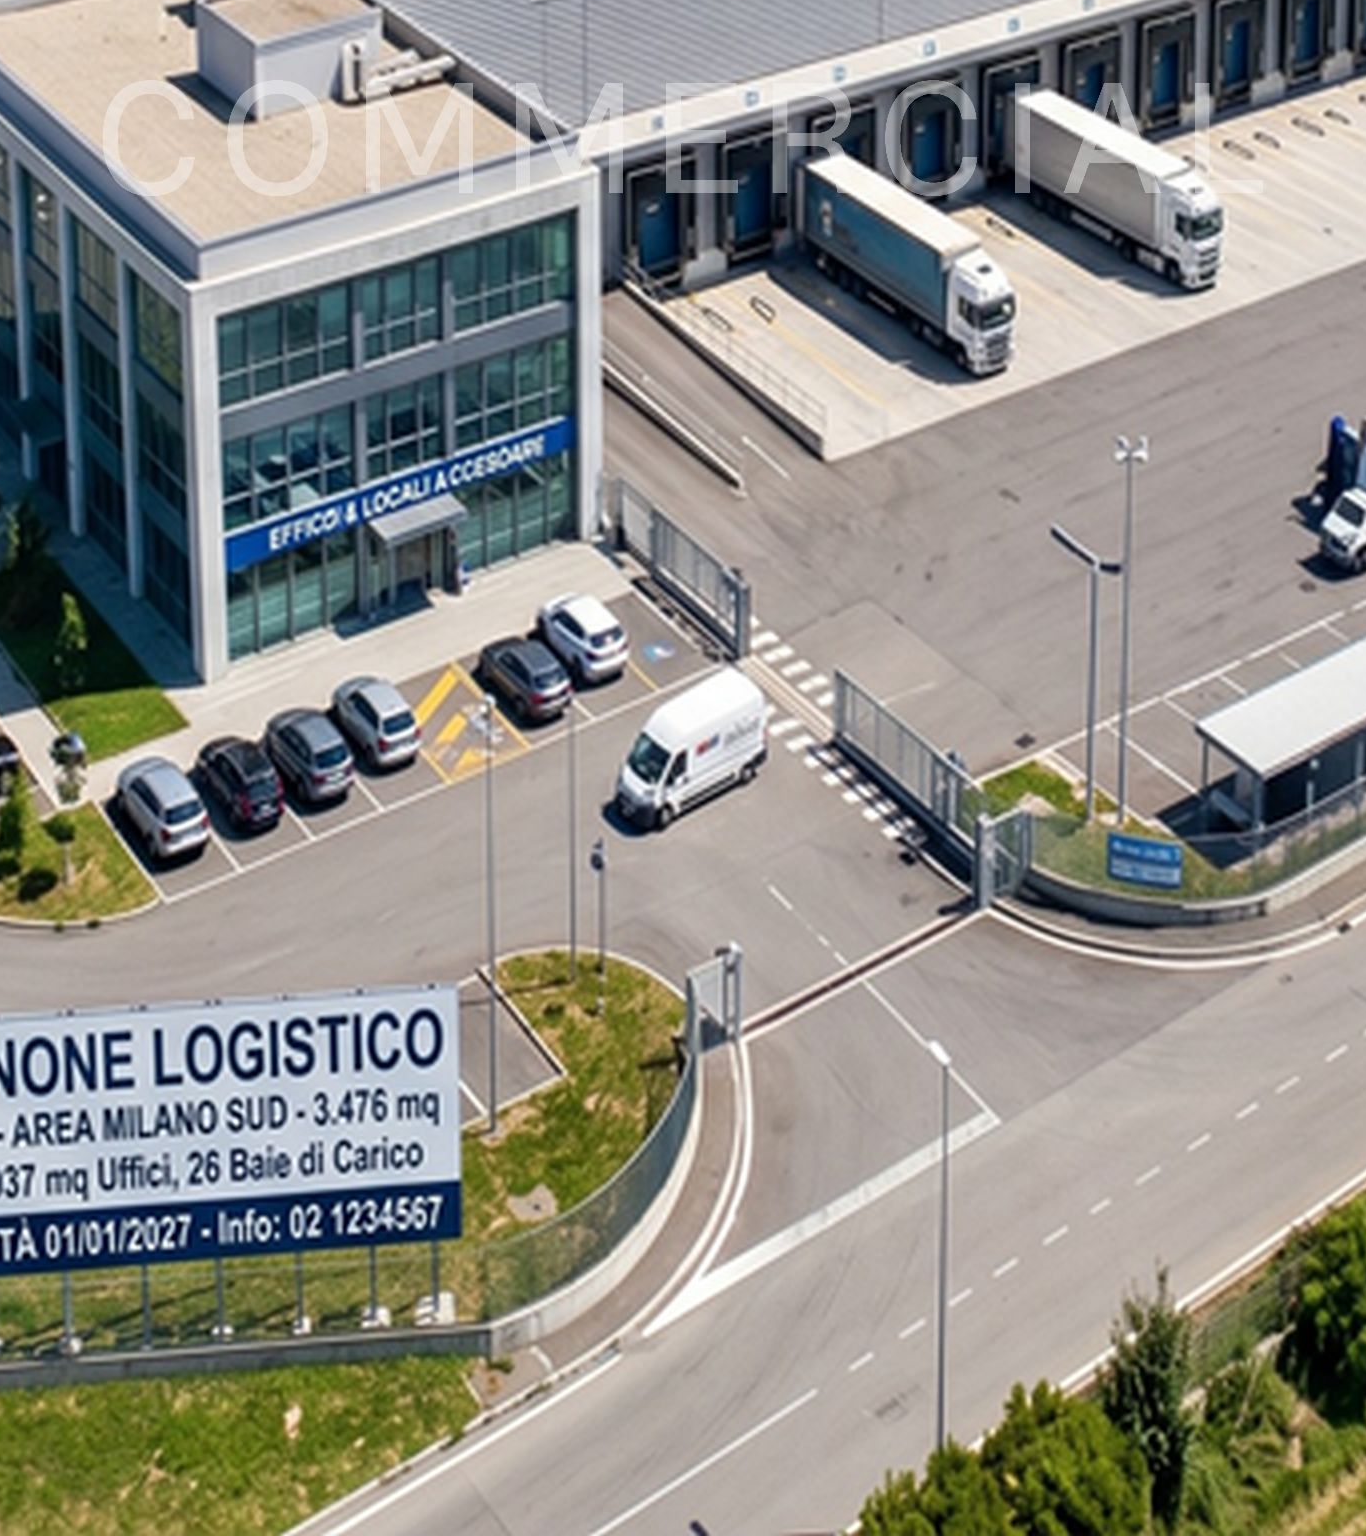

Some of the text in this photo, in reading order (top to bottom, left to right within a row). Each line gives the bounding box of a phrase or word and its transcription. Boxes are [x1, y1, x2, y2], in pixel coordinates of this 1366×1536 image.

[362, 474, 431, 517] LOCALI
[153, 1008, 443, 1087] LOGISTICO
[11, 1110, 95, 1148] AREA
[102, 1099, 218, 1142] MILANO
[226, 1095, 287, 1133] SUD
[313, 1088, 388, 1126] 3.476
[396, 1092, 440, 1125] mq
[46, 1167, 89, 1201] mq
[98, 1153, 179, 1191] Uffici,
[188, 1150, 221, 1185] 26
[230, 1145, 291, 1182] Baie
[298, 1141, 325, 1175] di
[333, 1136, 424, 1174] Carico
[45, 1215, 192, 1258] 01/01/2027
[218, 1209, 281, 1245] Info:
[288, 1203, 323, 1239] 02
[331, 1195, 443, 1235] 1234567
